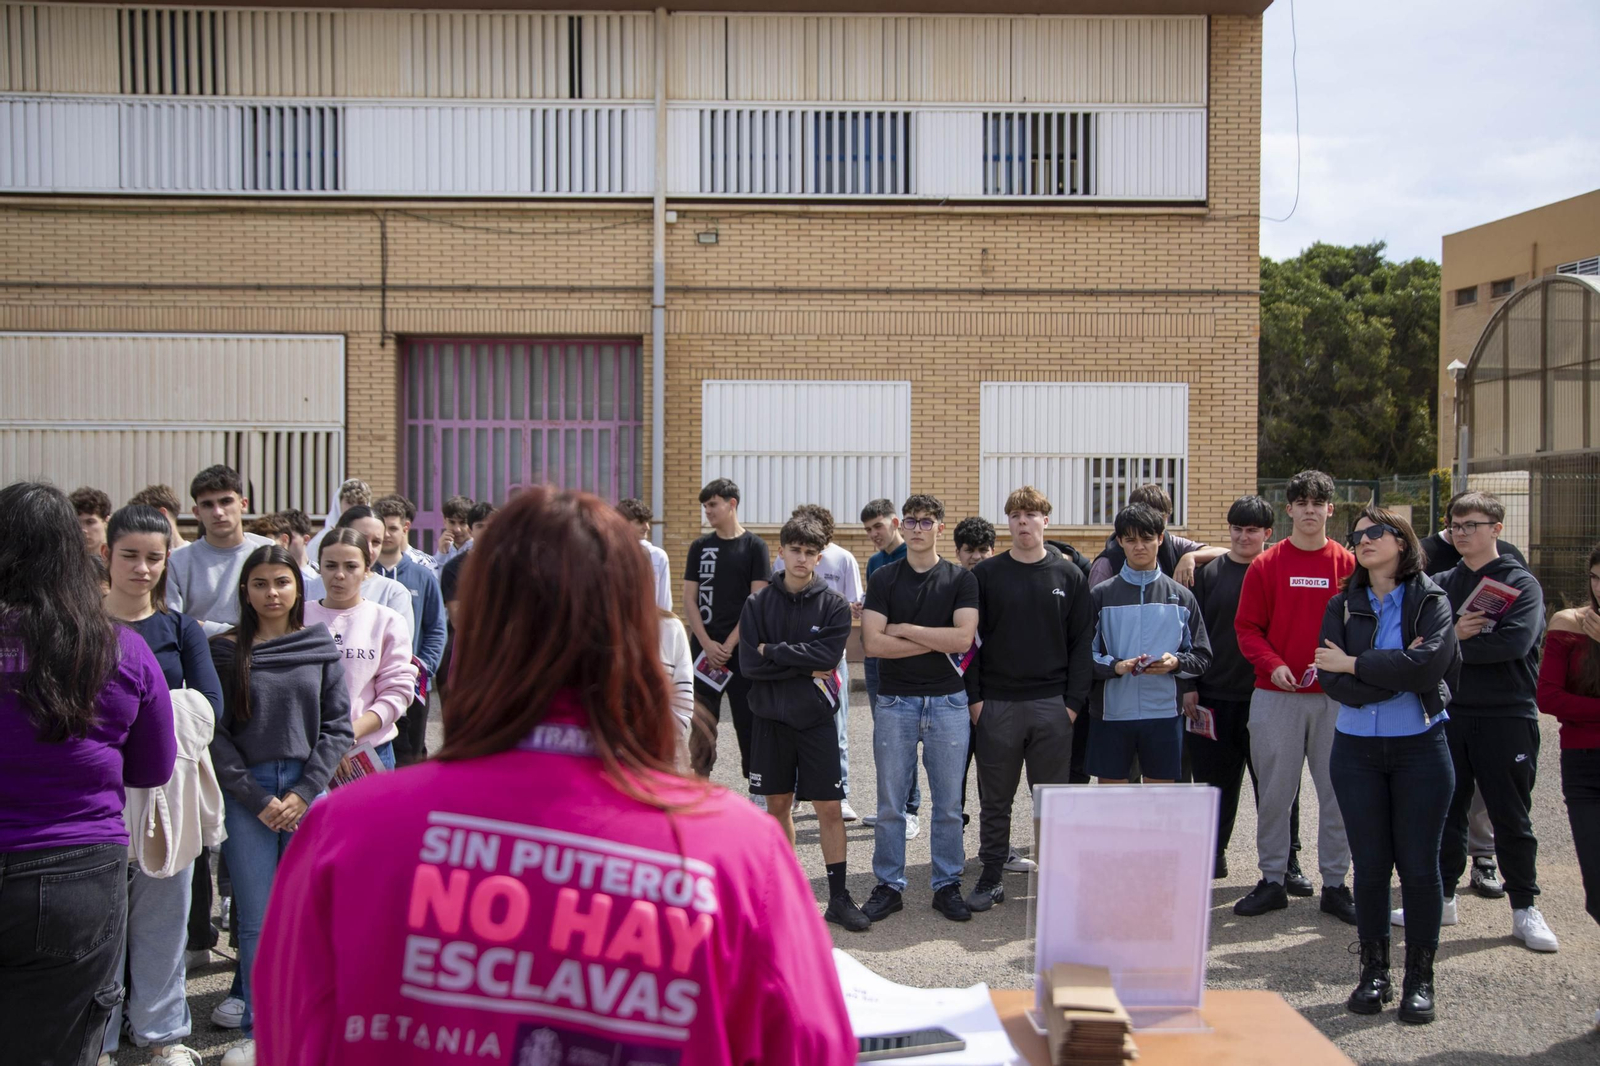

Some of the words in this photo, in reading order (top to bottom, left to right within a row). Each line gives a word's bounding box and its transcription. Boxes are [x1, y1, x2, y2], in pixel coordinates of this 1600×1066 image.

[698, 547, 719, 625] KENZO
[340, 648, 375, 660] ERS
[419, 825, 501, 873] SIN
[509, 839, 718, 914] PUTEROS
[407, 863, 530, 943] NO
[550, 887, 714, 974] HAY
[401, 934, 701, 1026] ESCLAVAS
[344, 1013, 502, 1059] BETANIA
